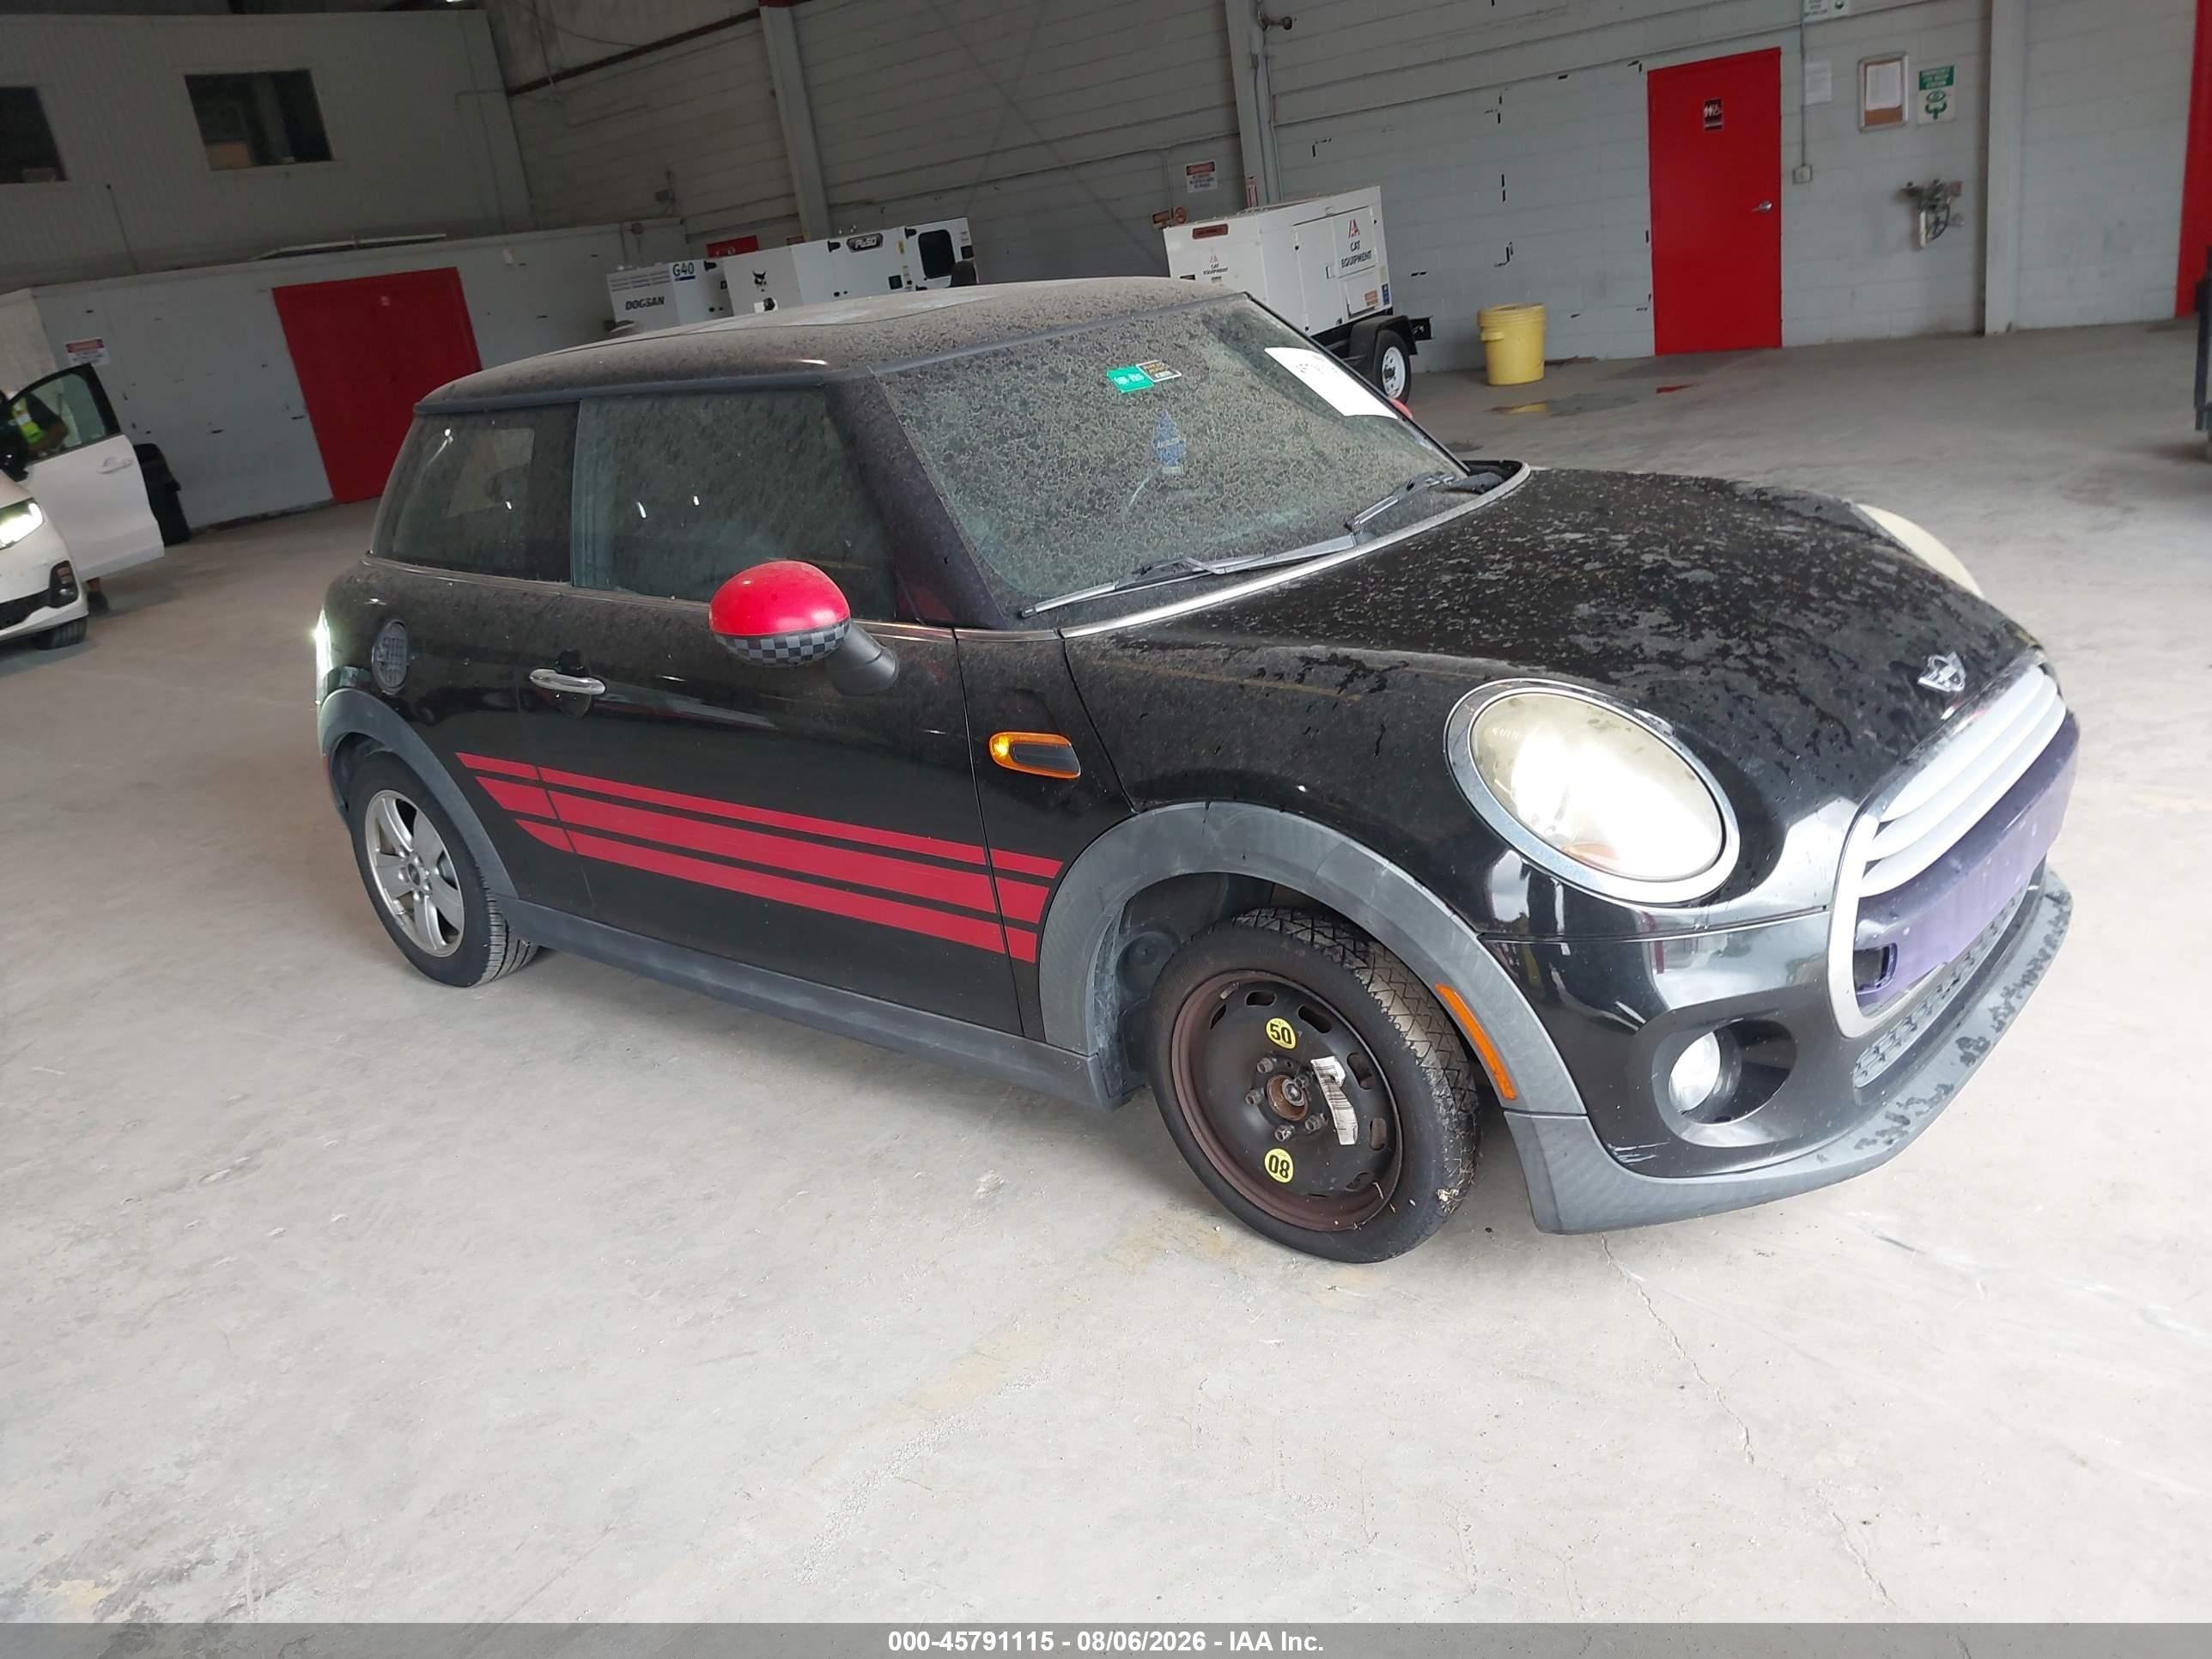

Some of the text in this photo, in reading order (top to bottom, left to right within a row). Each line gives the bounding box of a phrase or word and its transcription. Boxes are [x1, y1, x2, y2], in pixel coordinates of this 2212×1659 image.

[1341, 250, 1372, 268] EQUIPMENT
[672, 262, 694, 276] G40
[1270, 1022, 1291, 1045] 50
